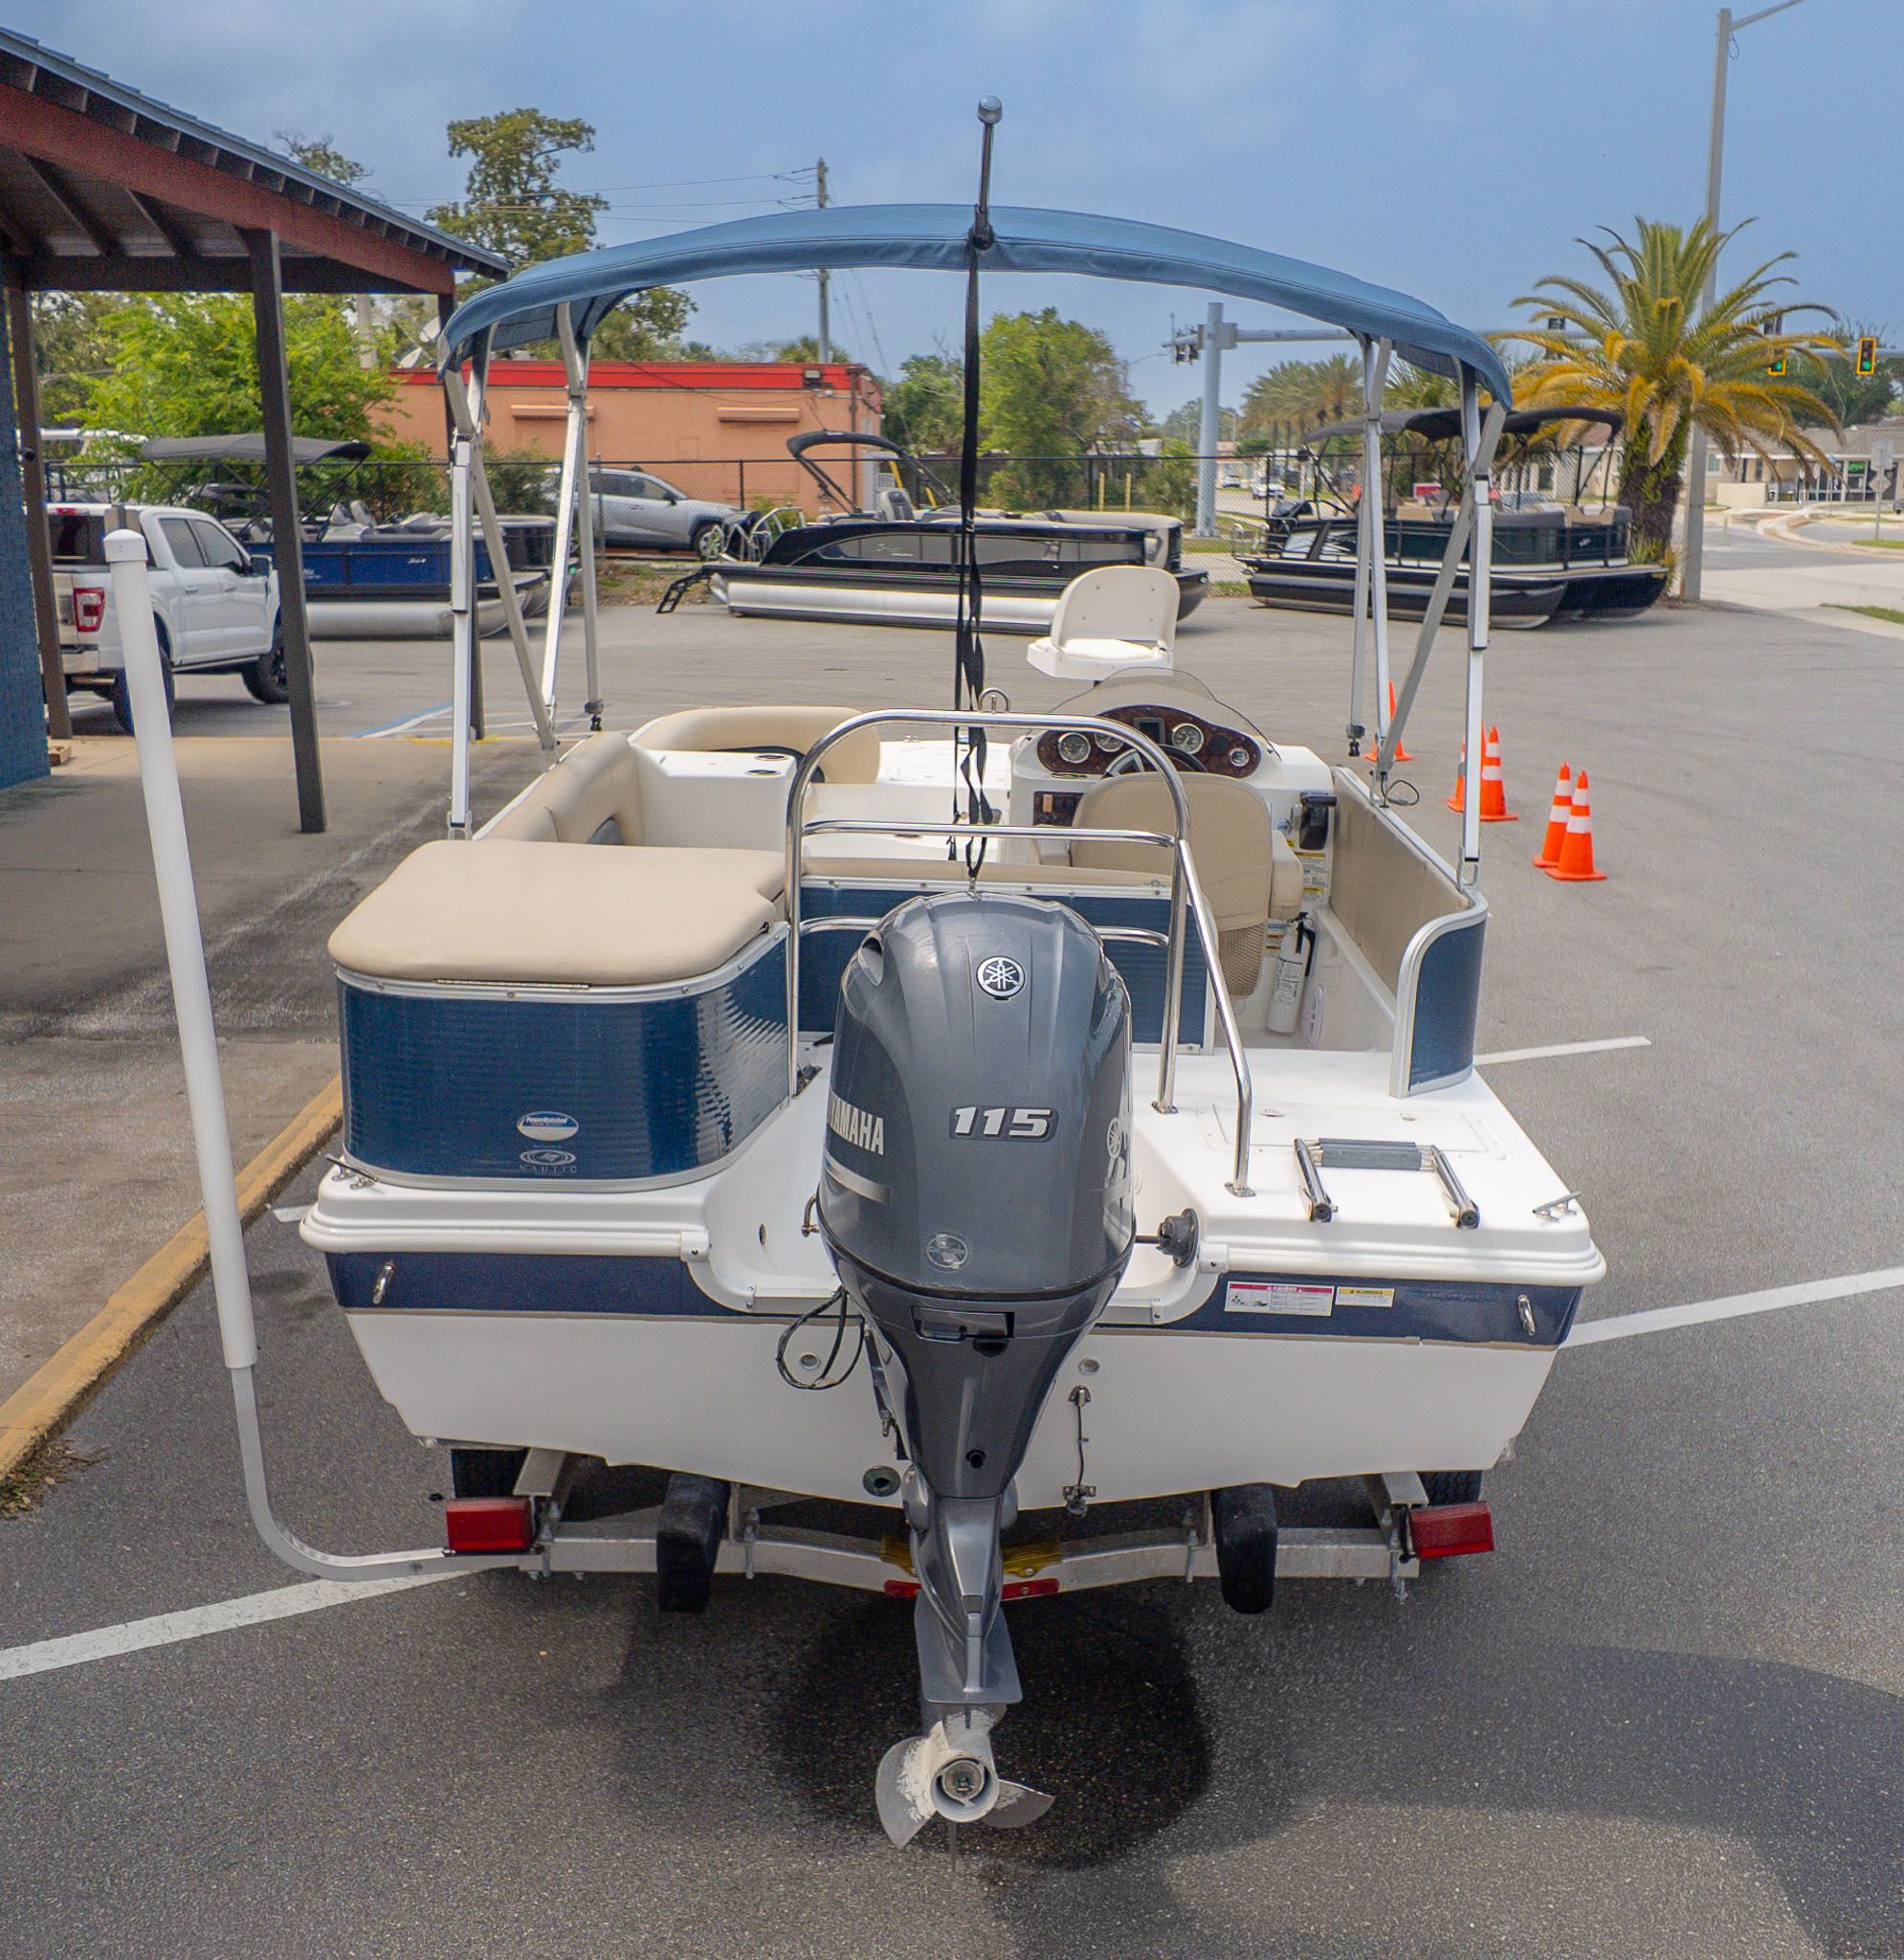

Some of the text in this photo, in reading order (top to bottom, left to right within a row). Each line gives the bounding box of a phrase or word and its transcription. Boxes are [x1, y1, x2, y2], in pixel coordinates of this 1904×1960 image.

[829, 1090, 884, 1156] YAMAHA
[955, 1106, 1052, 1138] 115
[520, 1165, 577, 1173] NAUTIC
